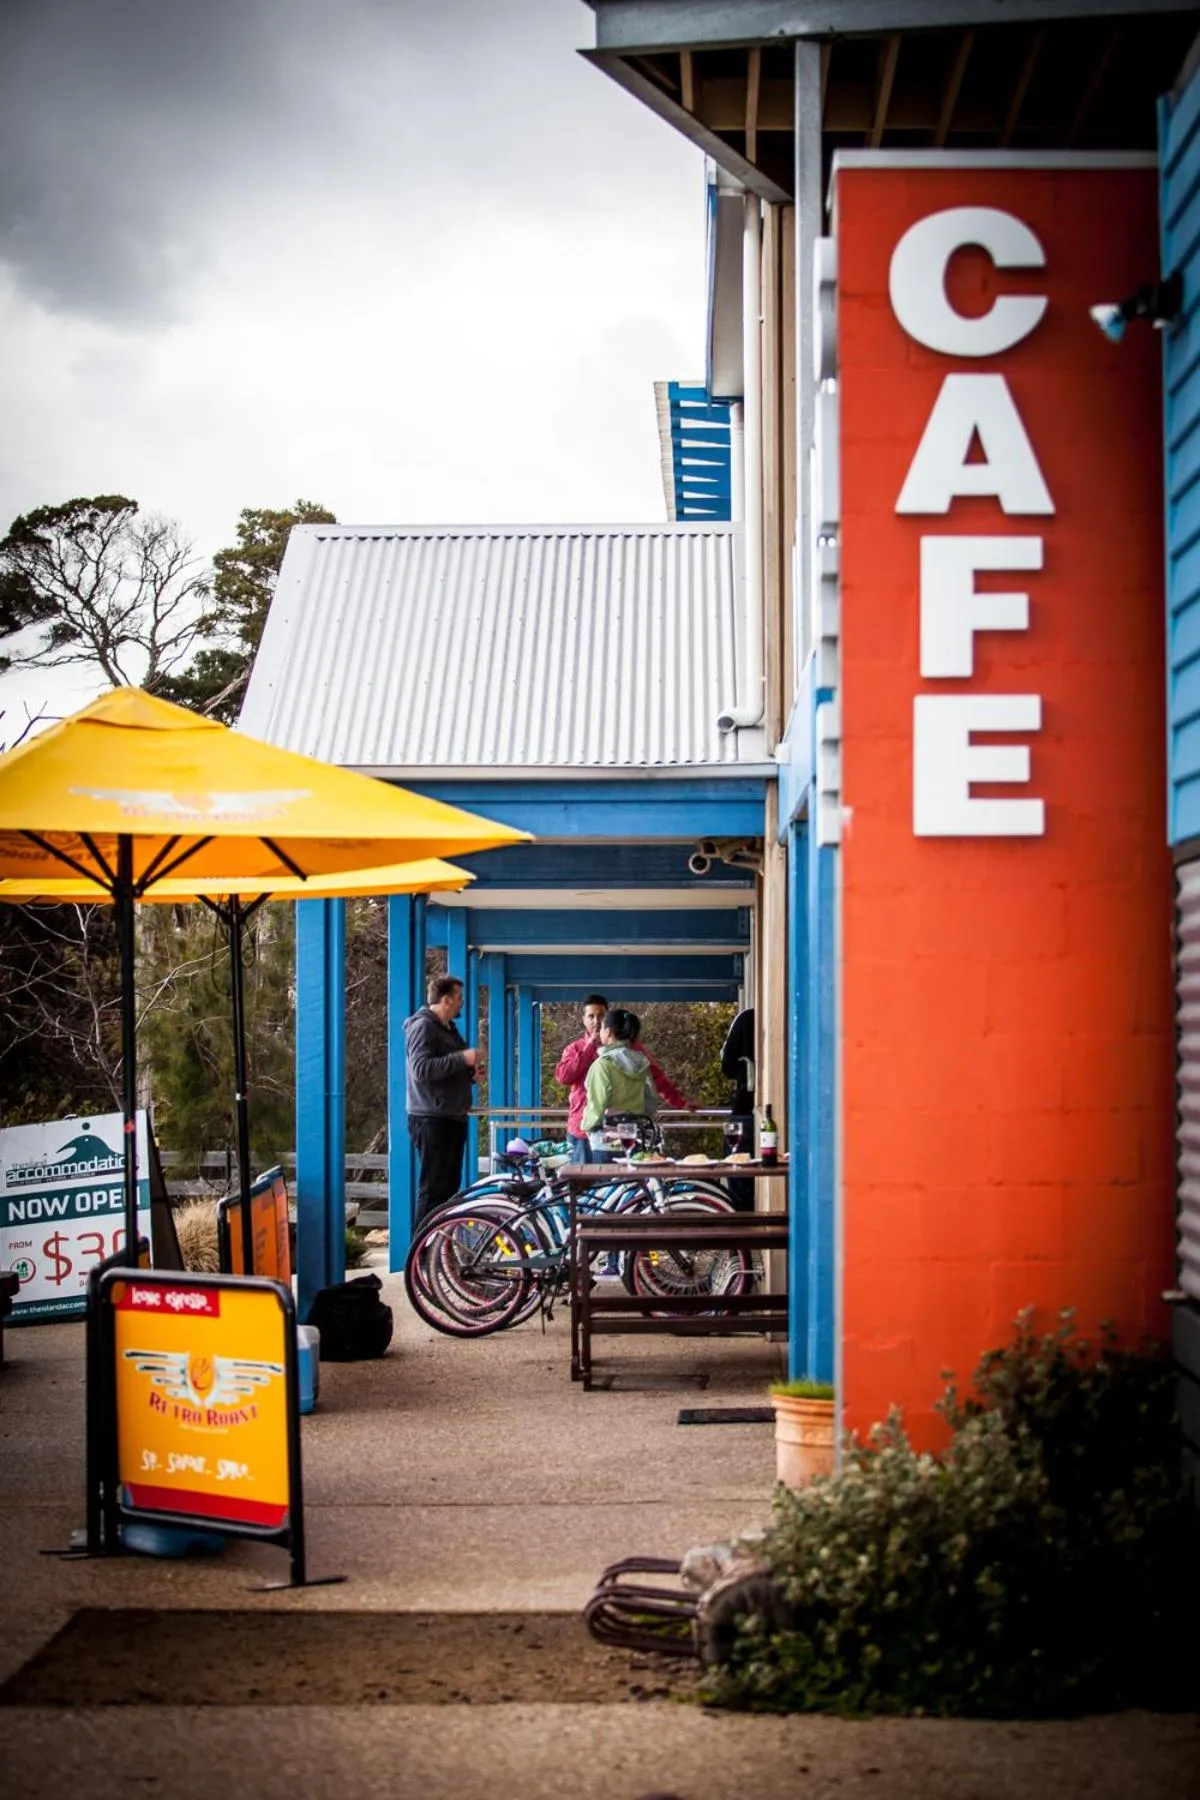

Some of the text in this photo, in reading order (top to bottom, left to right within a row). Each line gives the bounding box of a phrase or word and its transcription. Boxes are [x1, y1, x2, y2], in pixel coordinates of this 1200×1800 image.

[889, 206, 1055, 836] CAFE
[7, 1155, 125, 1181] accommodatio
[8, 1195, 70, 1221] NOW
[9, 1240, 32, 1250] FROM
